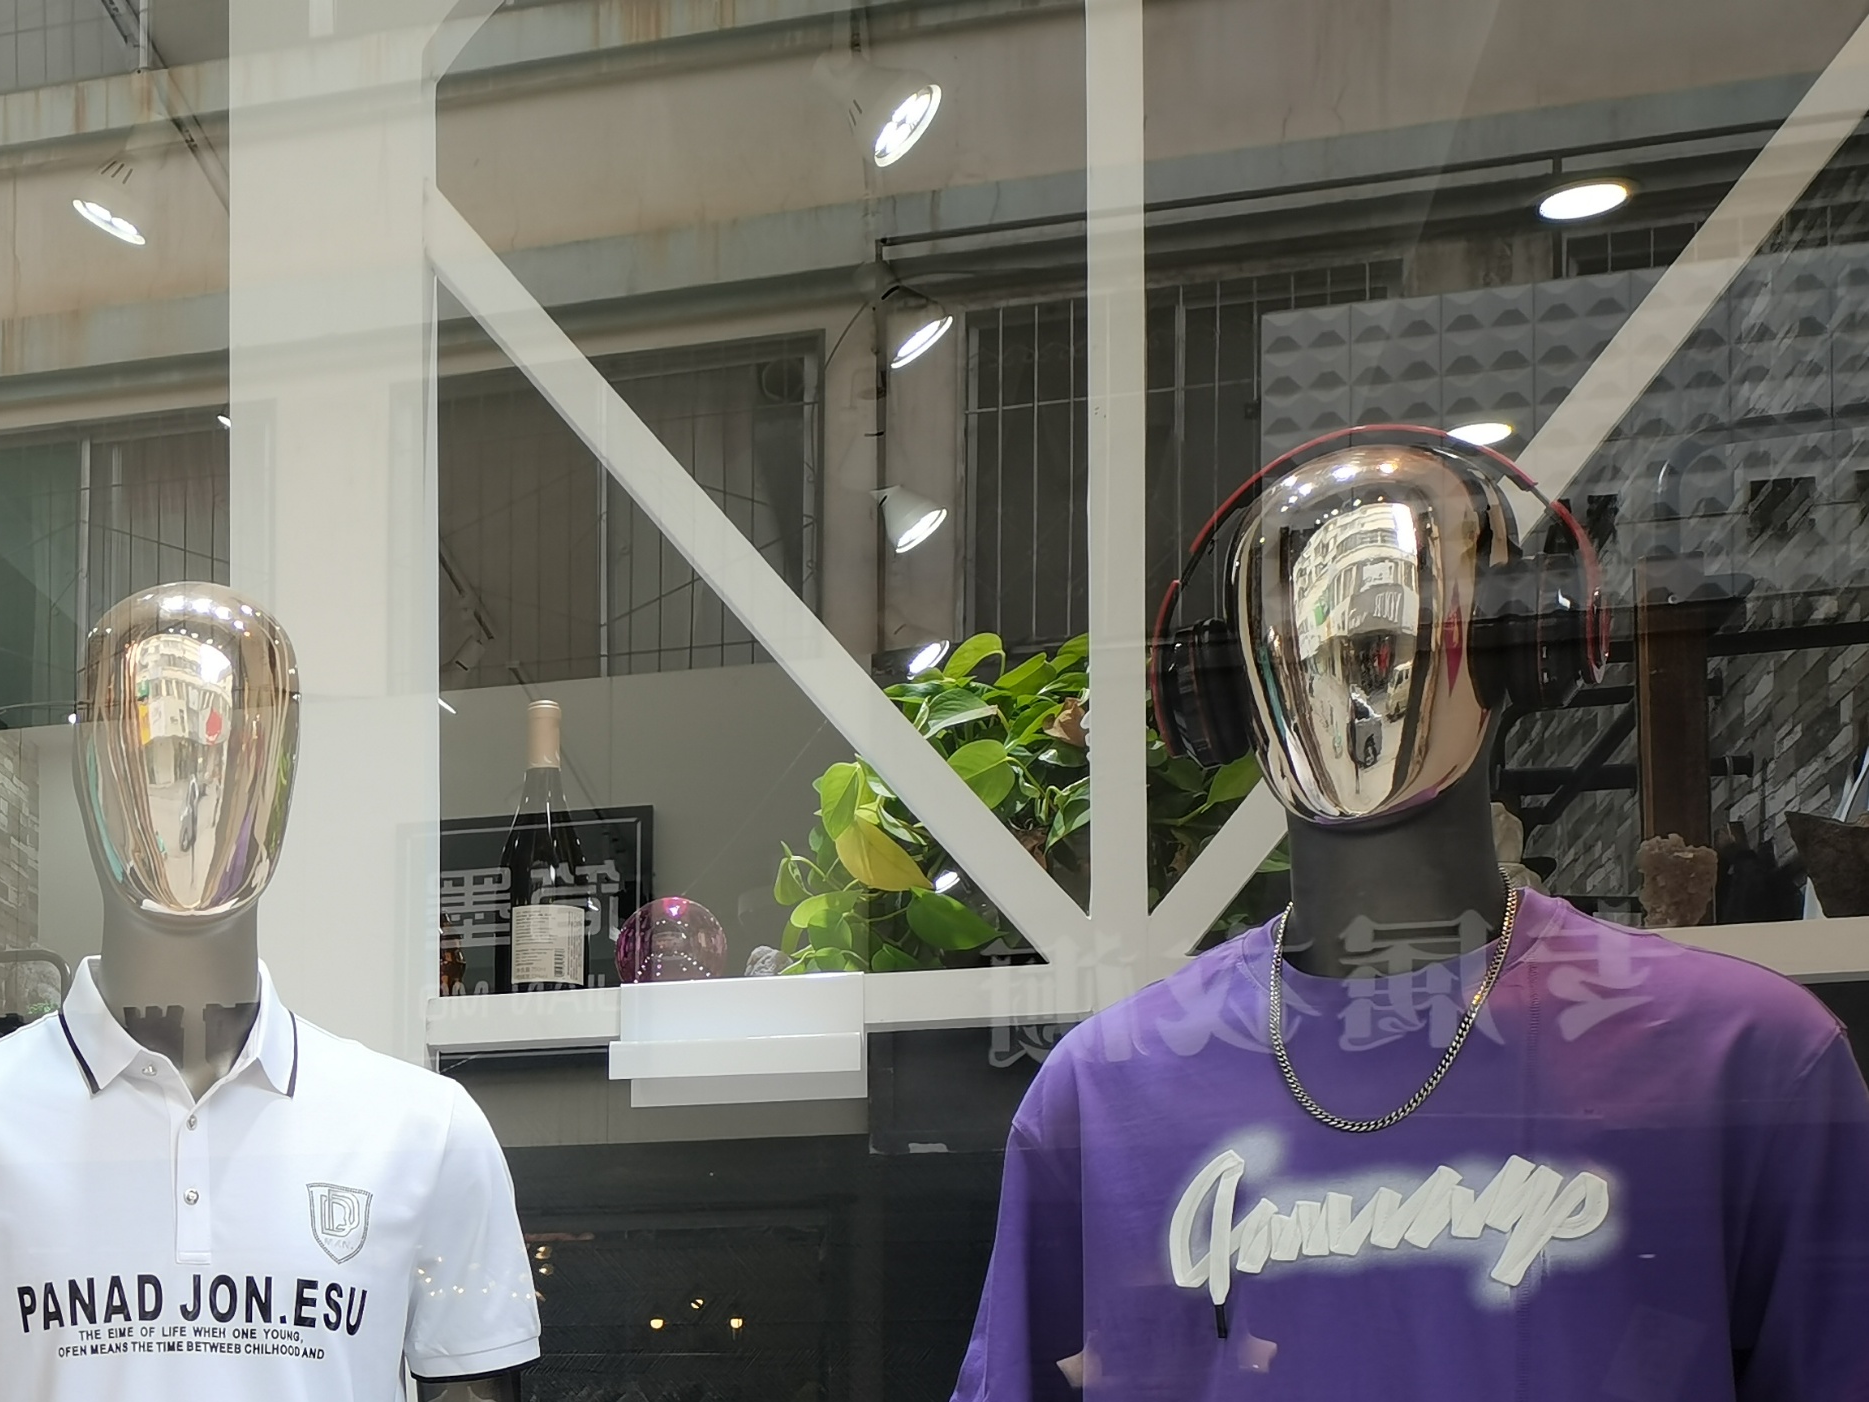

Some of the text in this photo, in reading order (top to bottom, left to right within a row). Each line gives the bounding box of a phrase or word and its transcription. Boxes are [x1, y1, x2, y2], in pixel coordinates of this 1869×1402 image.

[17, 1273, 369, 1336] PANAD JON.ESU
[79, 1329, 101, 1340] THE
[140, 1326, 155, 1337] OF
[162, 1326, 187, 1337] LIFE
[232, 1328, 257, 1339] ONE
[90, 1341, 128, 1355] MEANS
[131, 1341, 154, 1352] THE
[156, 1341, 184, 1352] TIME
[301, 1347, 325, 1360] AND
